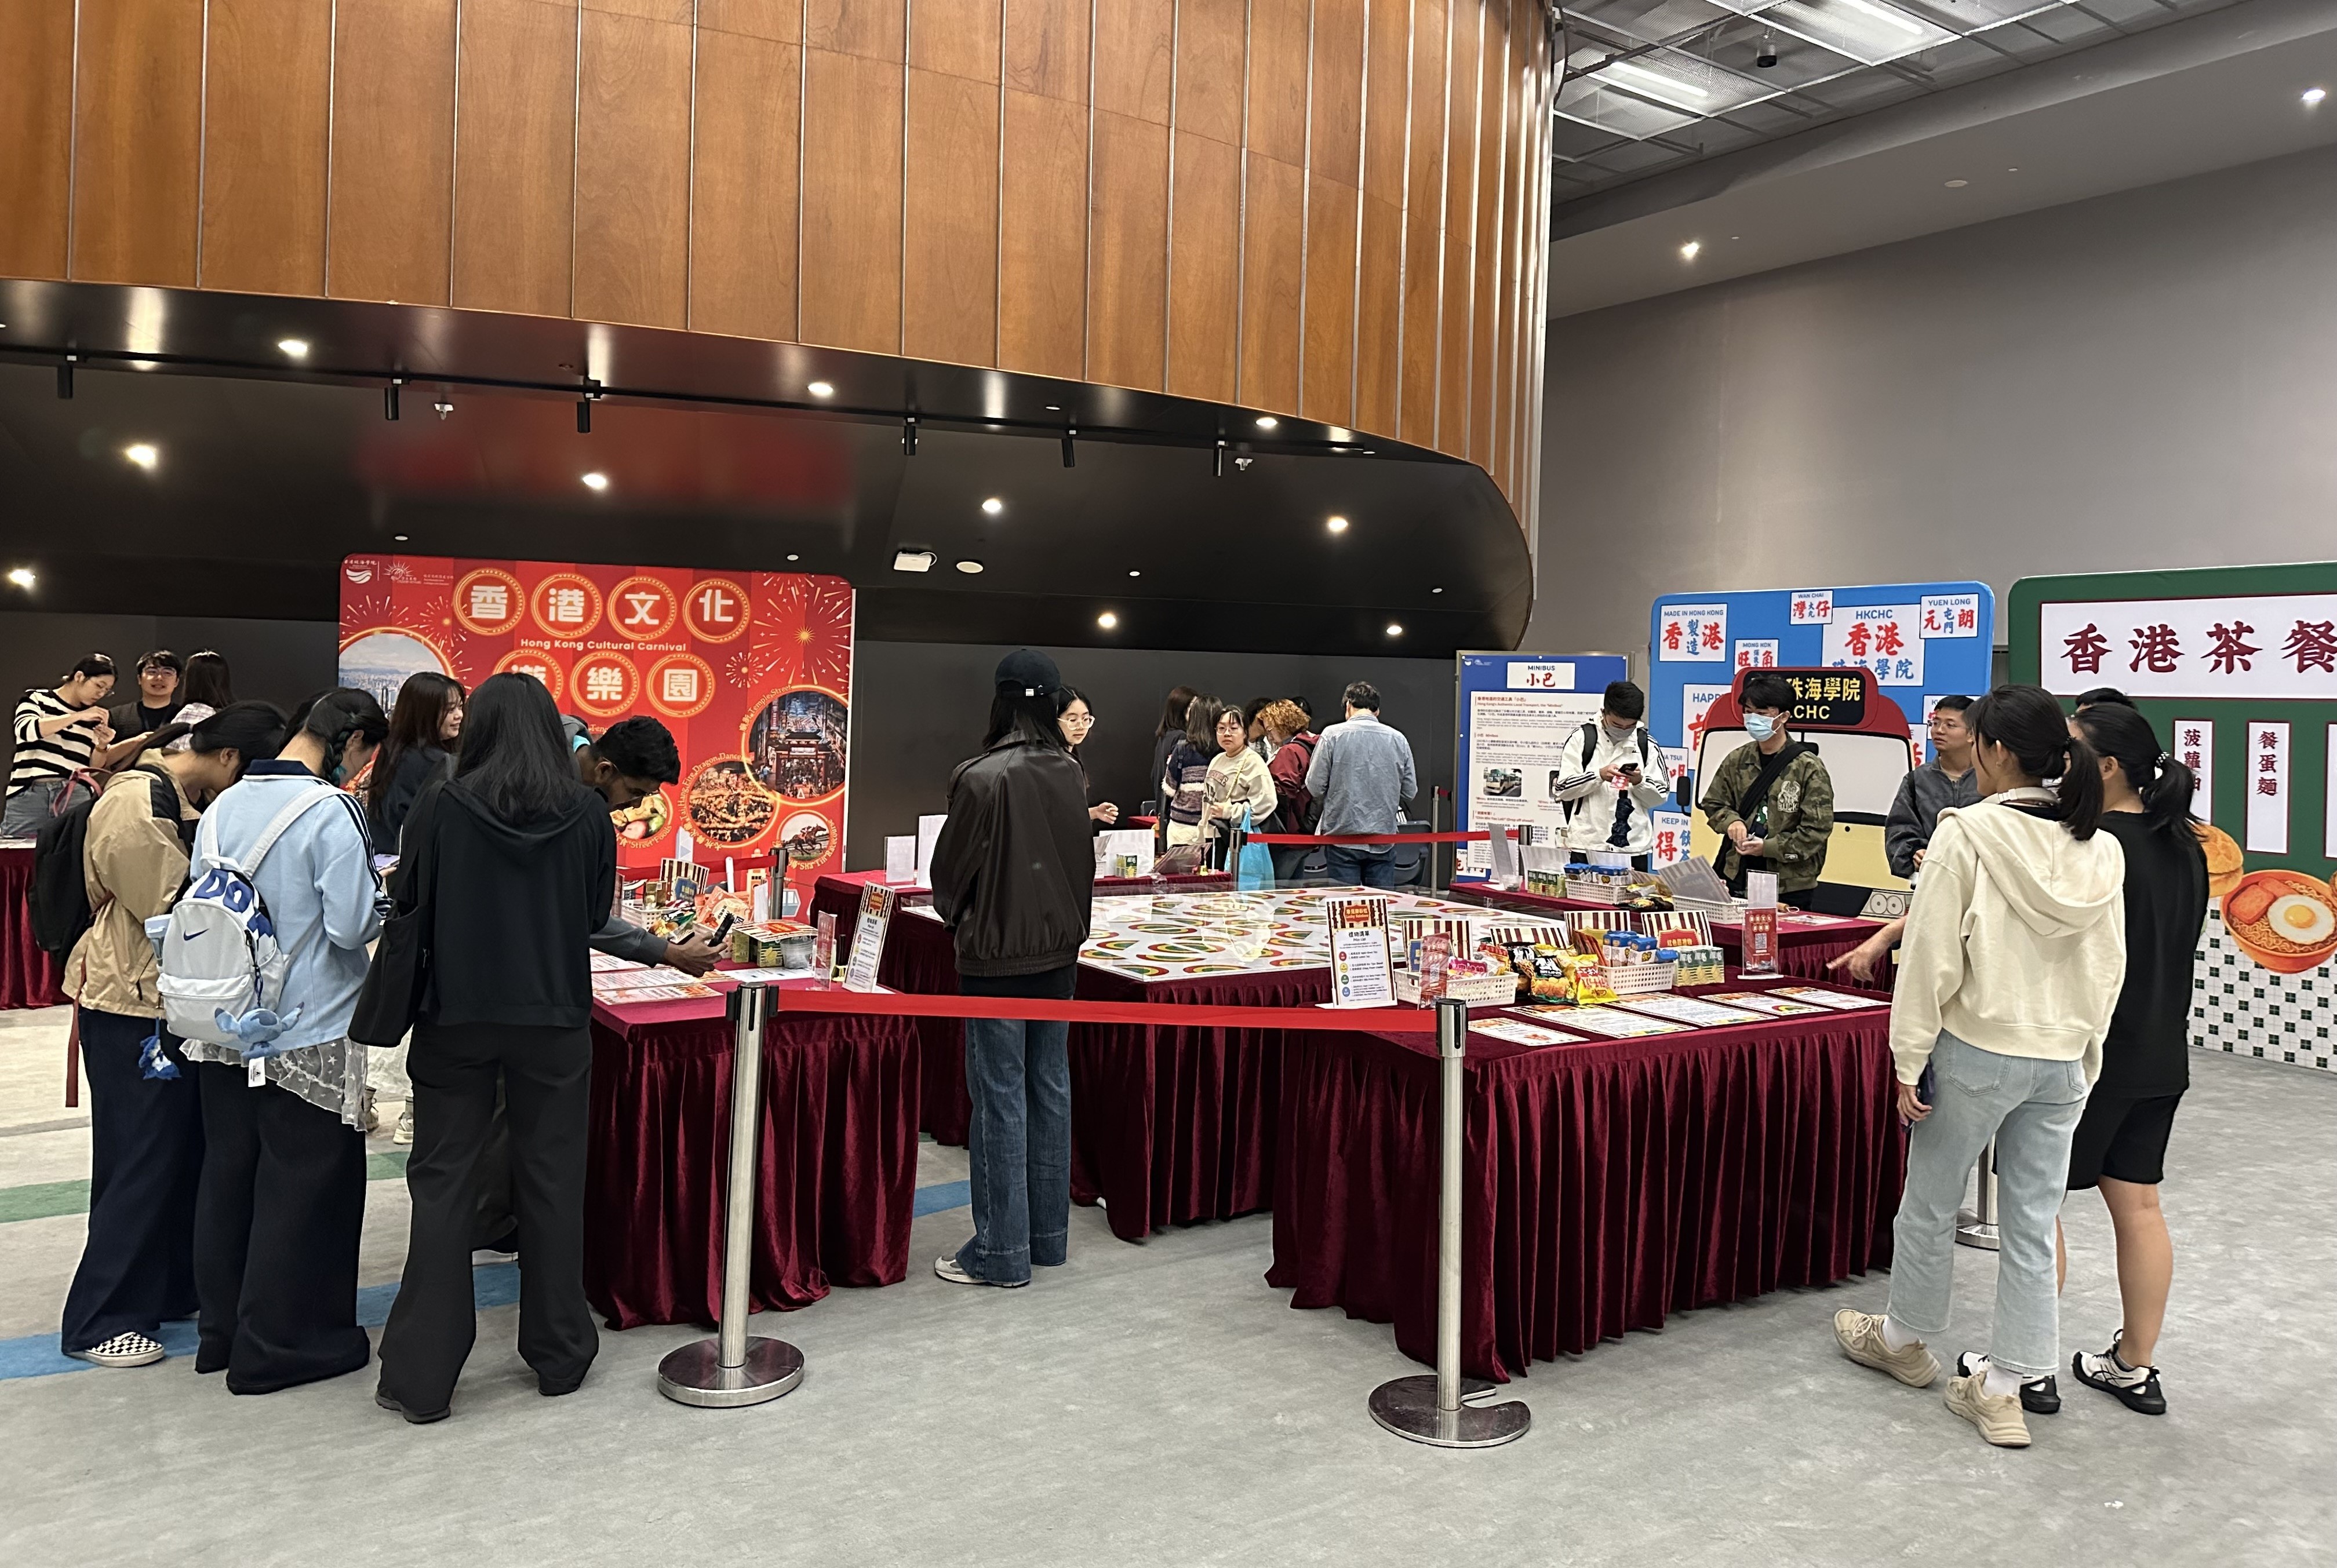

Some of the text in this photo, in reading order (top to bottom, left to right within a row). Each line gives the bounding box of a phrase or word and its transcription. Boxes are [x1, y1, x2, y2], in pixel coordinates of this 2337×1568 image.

[471, 585, 734, 625] 香港文化
[1855, 609, 1893, 620] HKCHC
[1928, 598, 1971, 607] YUEN LONG
[1943, 607, 1955, 635] 屯門
[520, 638, 687, 651] Hong Kong Cultural Carnival
[1686, 619, 1700, 655] 製造
[1844, 621, 1904, 657] 香港
[2060, 619, 2337, 675] 香港茶餐
[1526, 672, 1556, 687] 小巴
[748, 684, 791, 714] Temple Street
[1790, 705, 1830, 720] CHC
[692, 755, 719, 774] Dragon
[719, 752, 742, 760] Dance
[2257, 730, 2279, 797] 餐蛋麵
[1661, 816, 1688, 826] KEEP IN
[1655, 830, 1677, 862] 得
